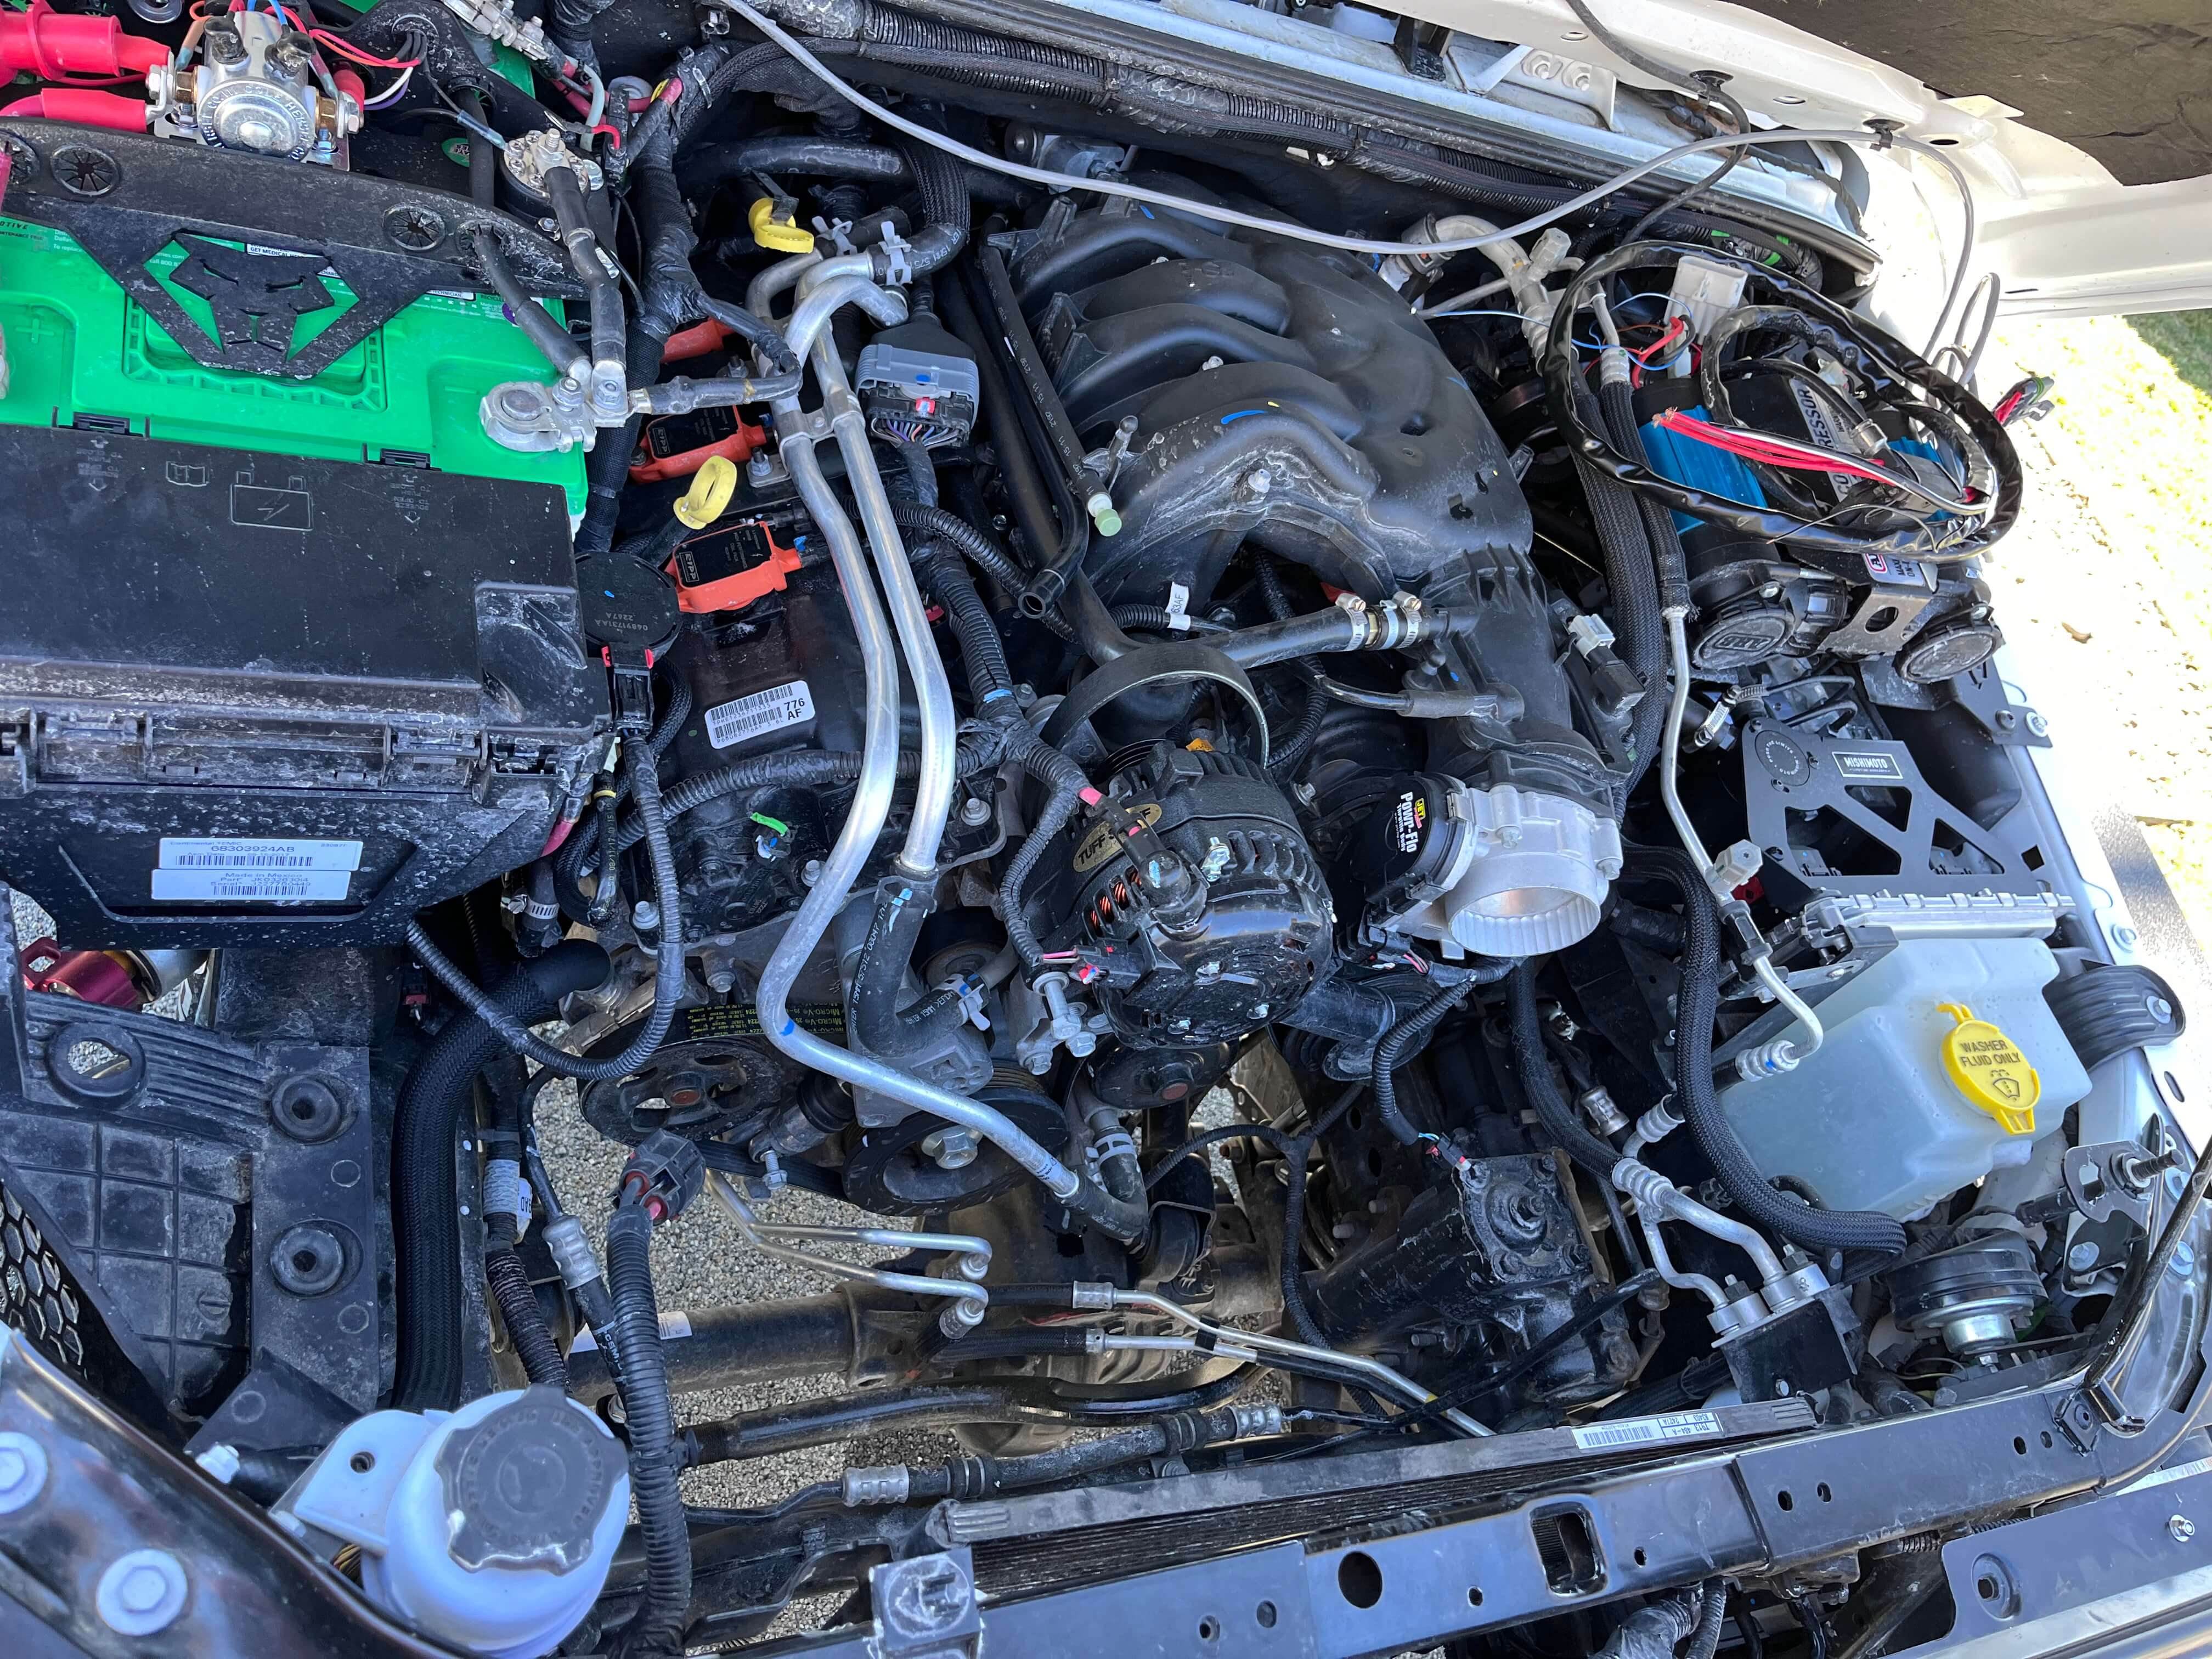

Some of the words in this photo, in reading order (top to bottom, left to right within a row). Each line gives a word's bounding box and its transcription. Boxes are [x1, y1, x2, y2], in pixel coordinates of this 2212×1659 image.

[685, 553, 696, 580] RIPP
[784, 698, 805, 712] 776
[787, 708, 802, 720] AF
[1843, 757, 1888, 769] MISHIMOTO
[1077, 833, 1106, 865] TUFF
[1960, 1040, 2008, 1053] WASHER
[1960, 1054, 1993, 1066] FLUID
[1993, 1053, 2021, 1064] ONLY
